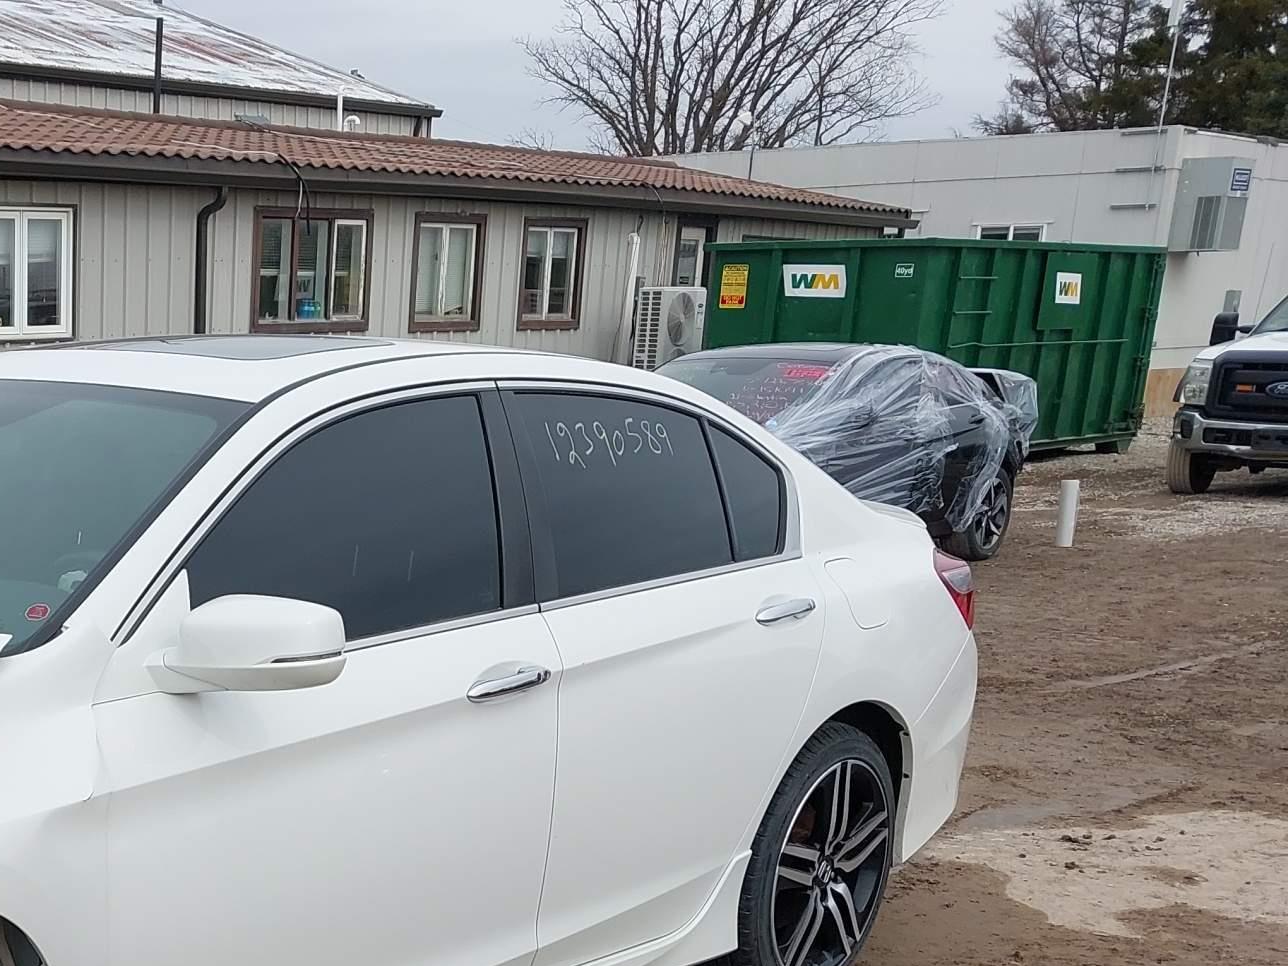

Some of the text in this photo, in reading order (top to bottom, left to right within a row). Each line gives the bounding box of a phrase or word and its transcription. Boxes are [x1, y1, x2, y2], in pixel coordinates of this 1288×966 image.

[791, 272, 840, 289] WM
[1058, 280, 1079, 297] WM
[544, 417, 674, 469] 12390589
